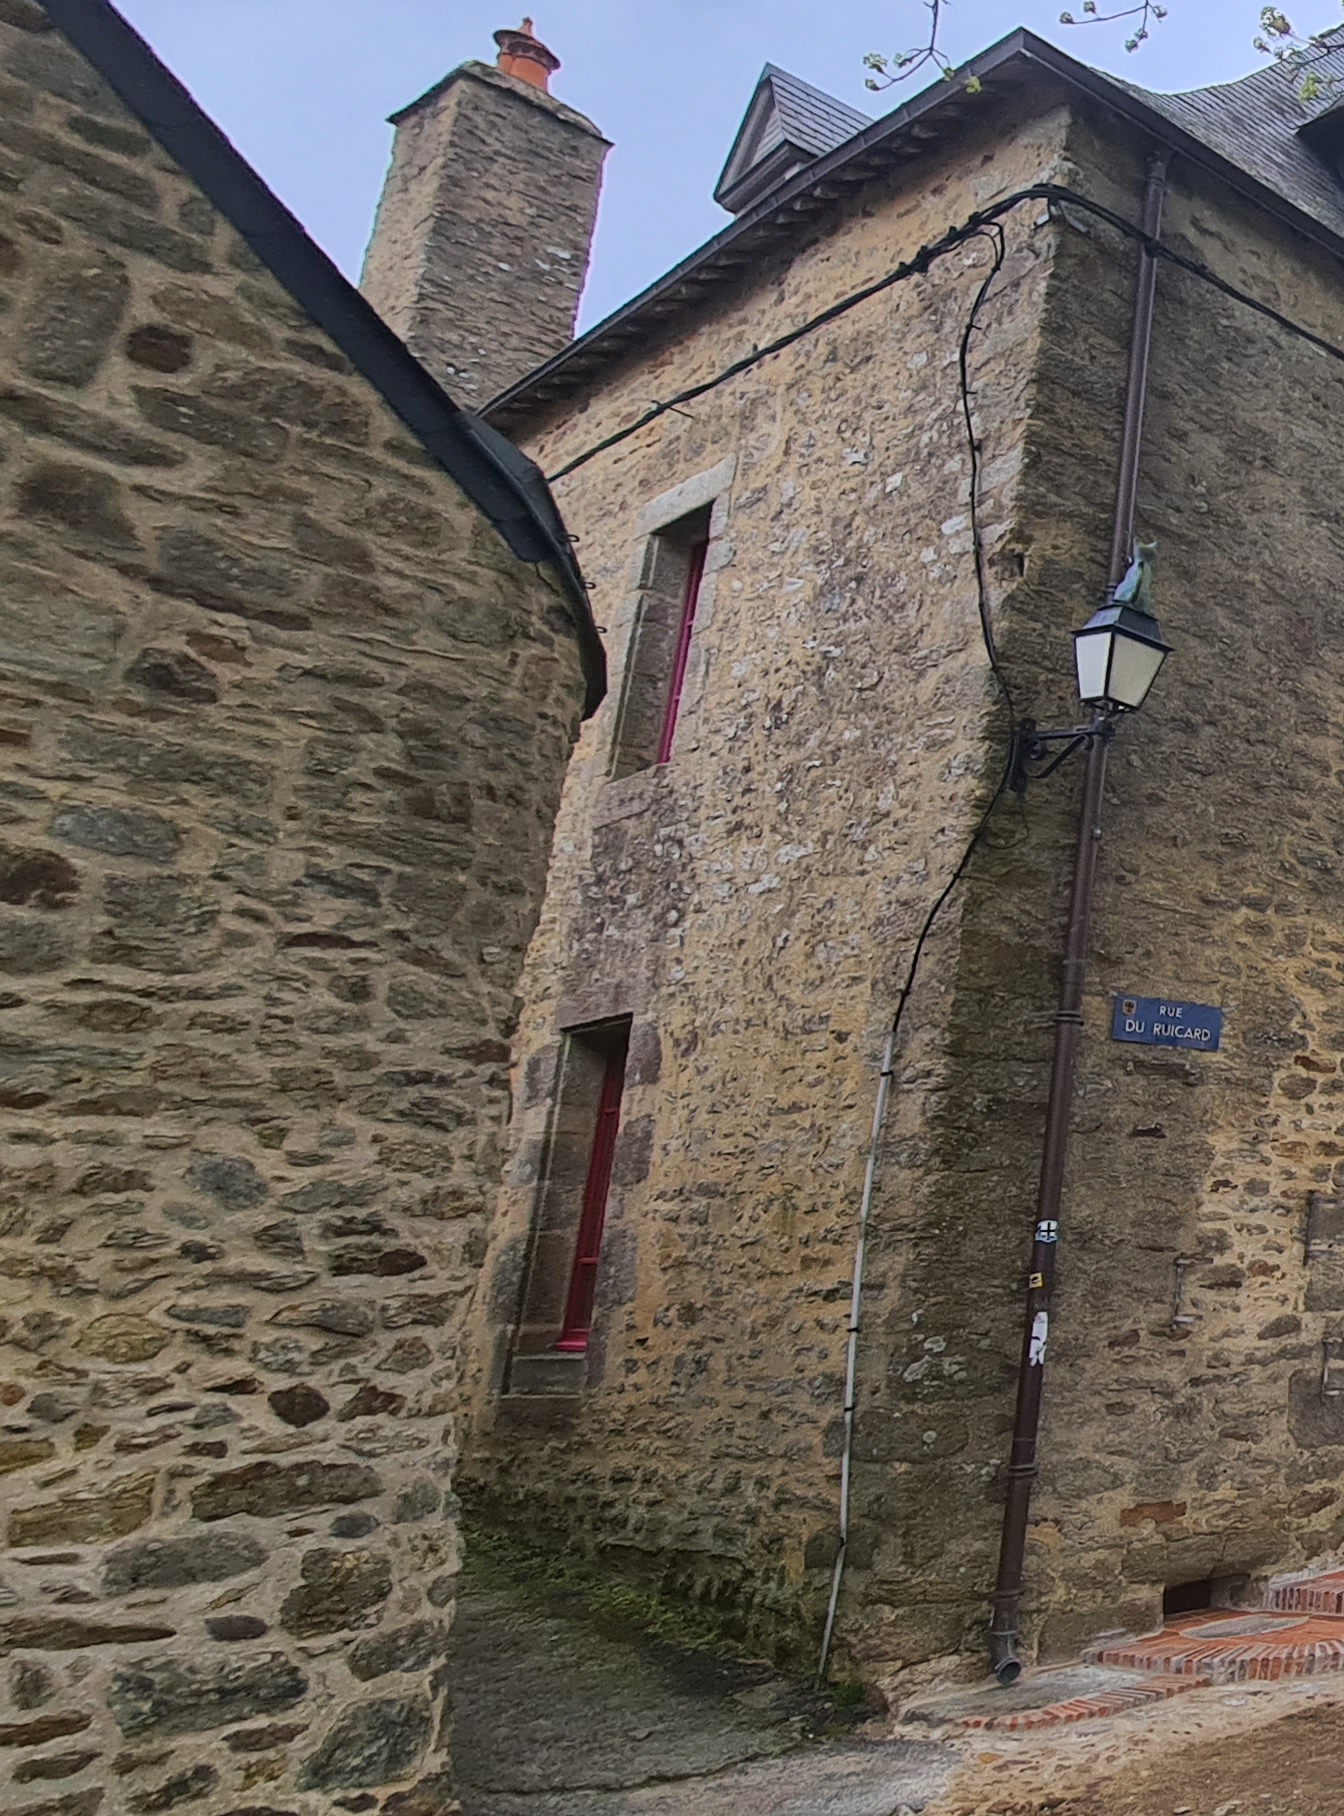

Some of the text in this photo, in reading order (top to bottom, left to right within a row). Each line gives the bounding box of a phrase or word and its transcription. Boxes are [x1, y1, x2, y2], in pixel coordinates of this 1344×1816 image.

[1159, 1005, 1183, 1018] RUE
[1125, 1019, 1211, 1042] DU RUICARD
